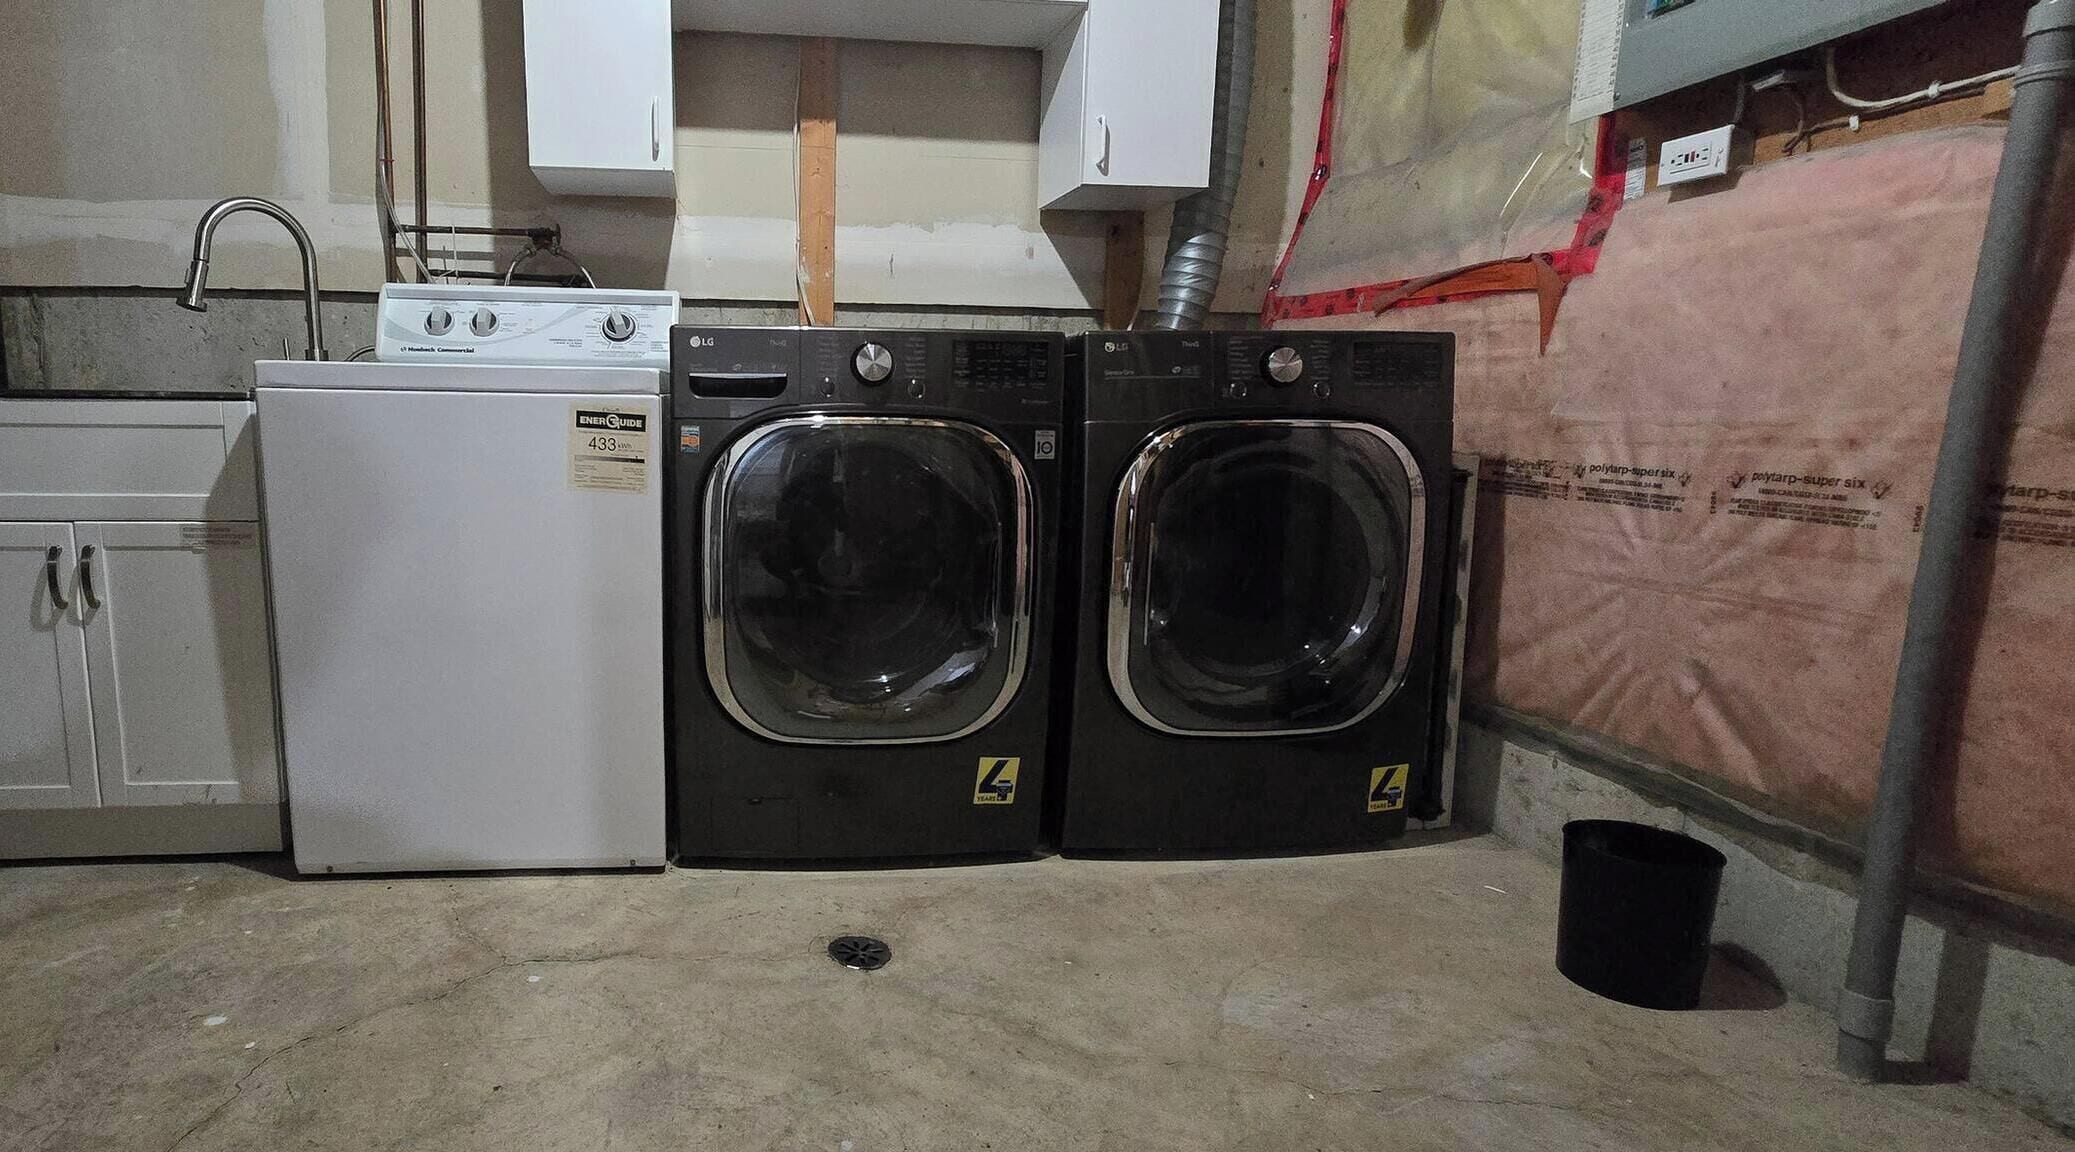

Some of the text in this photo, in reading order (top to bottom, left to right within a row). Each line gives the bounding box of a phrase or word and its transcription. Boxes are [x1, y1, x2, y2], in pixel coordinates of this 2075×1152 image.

[702, 337, 714, 346] LG
[1115, 342, 1129, 352] LG
[588, 436, 617, 452] 433
[1589, 463, 1677, 479] polytarp-super six
[1751, 471, 1866, 489] polytarp-super six
